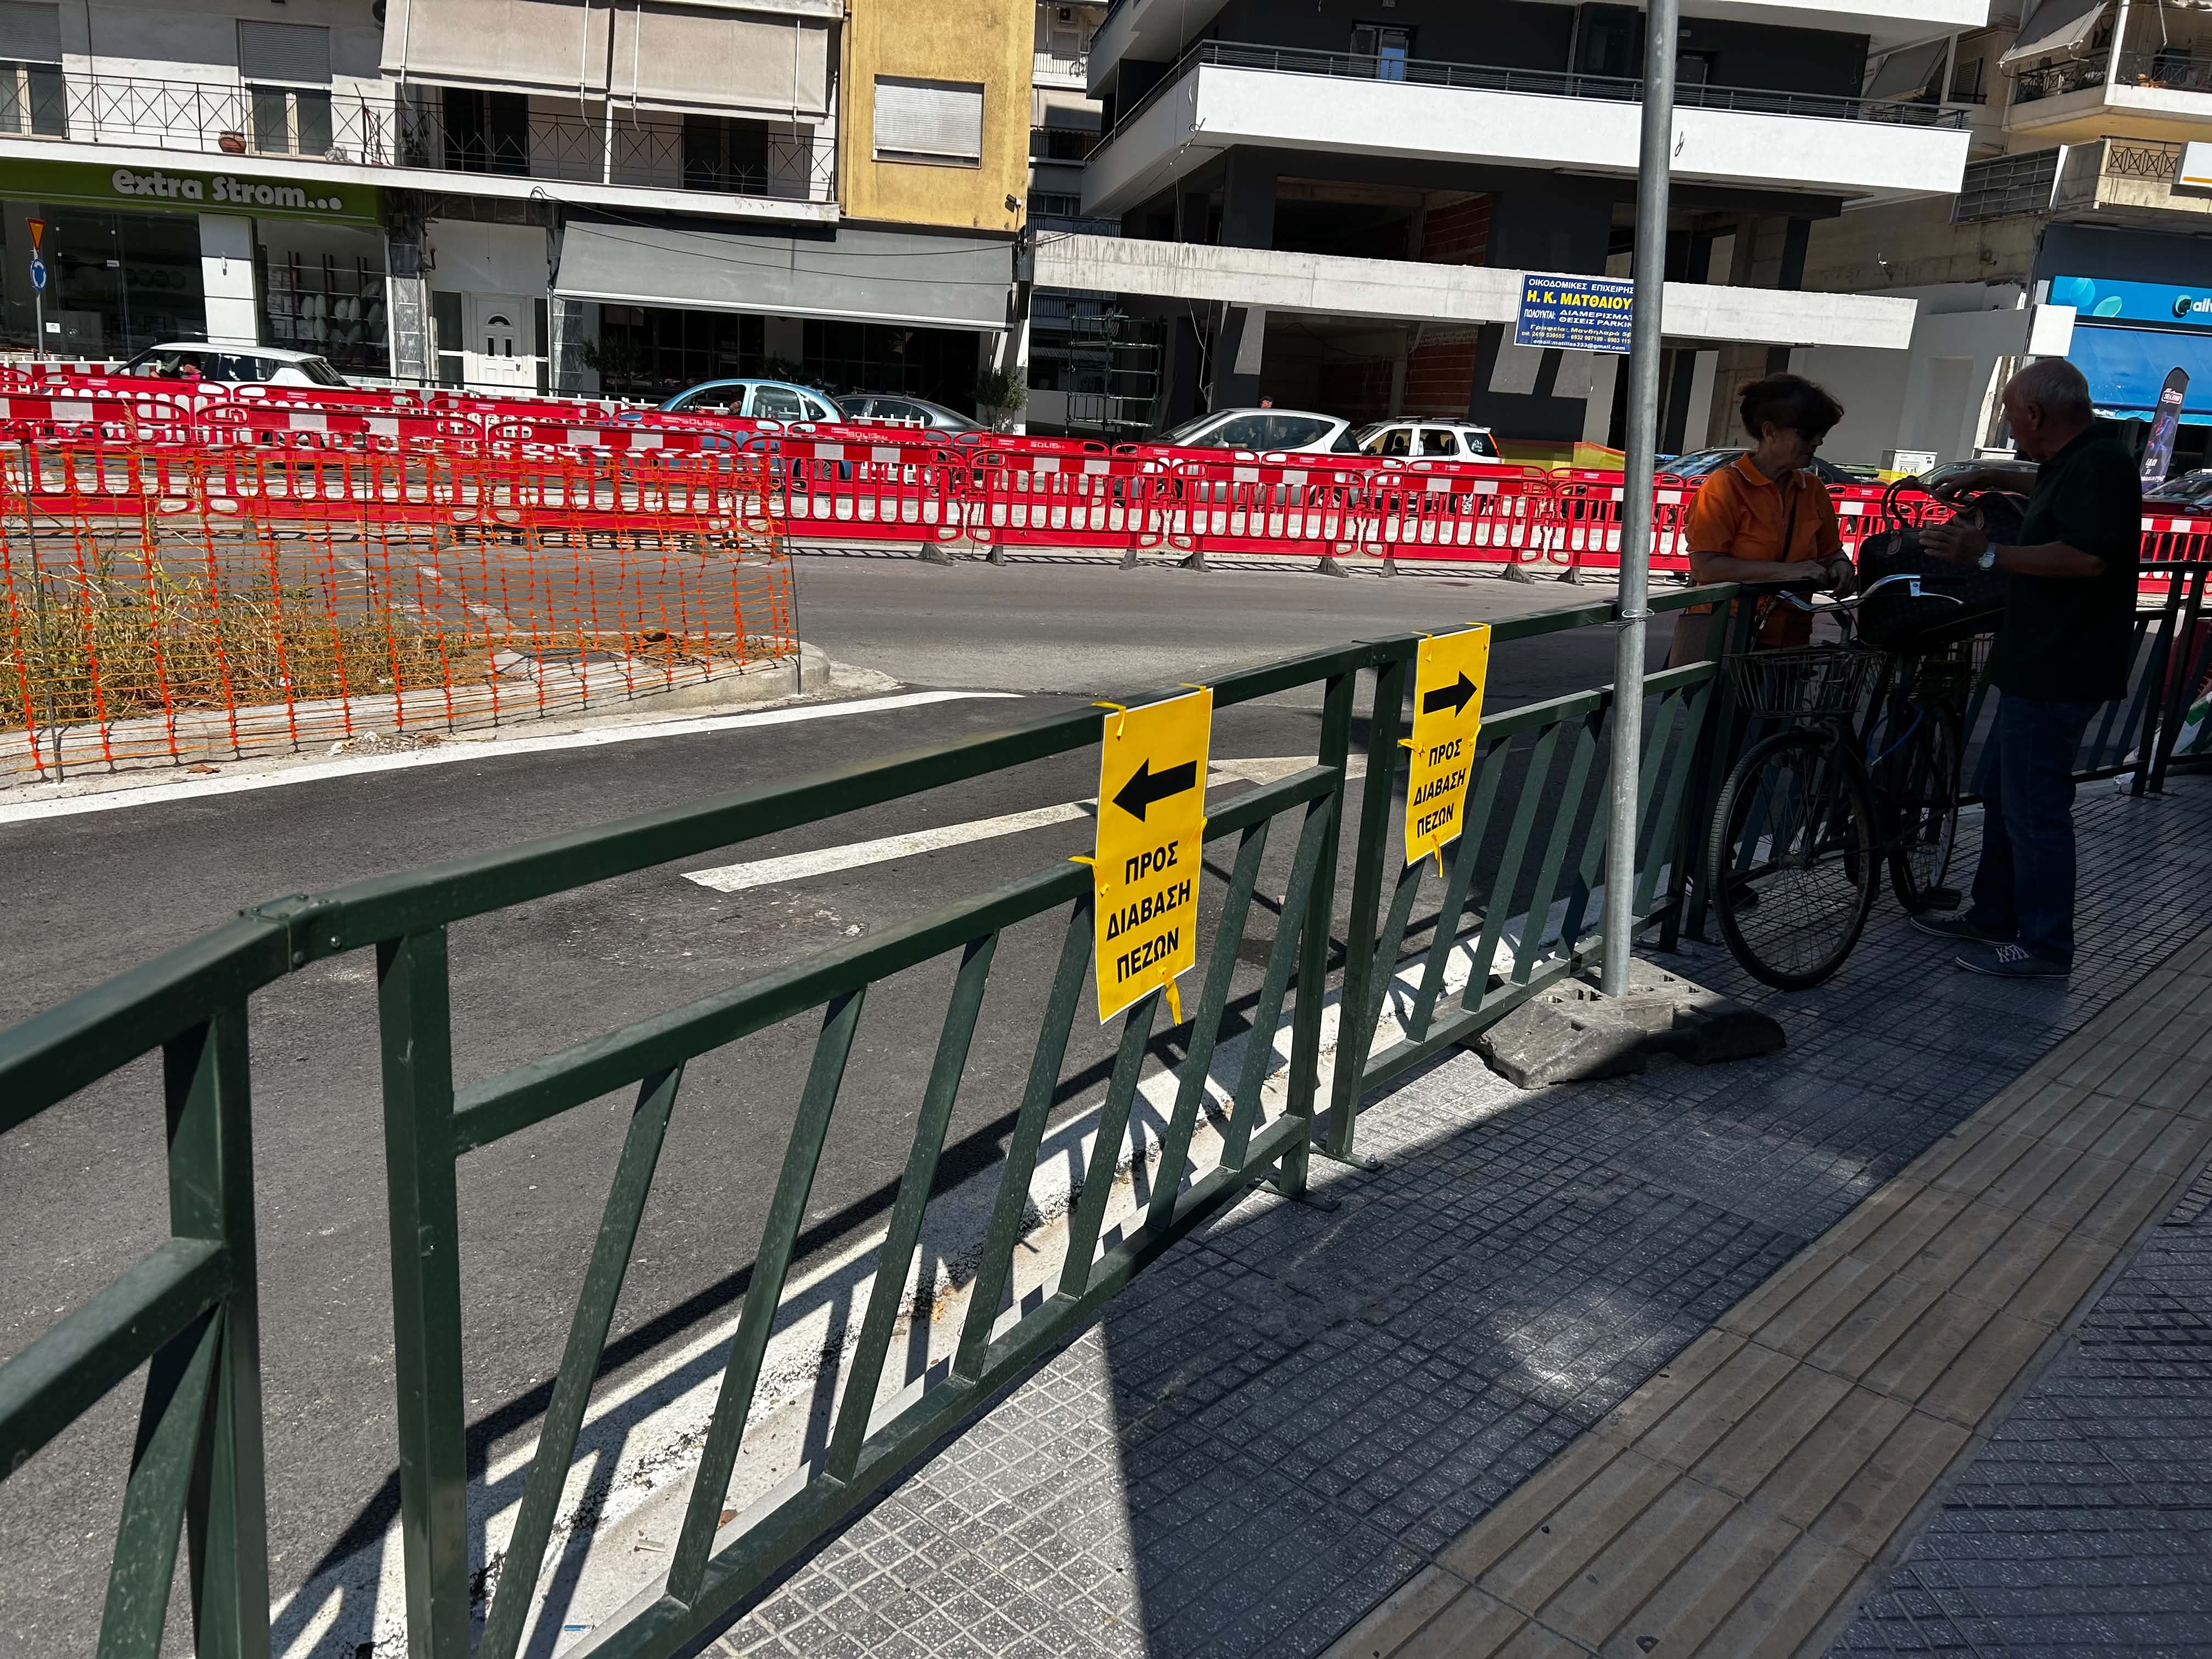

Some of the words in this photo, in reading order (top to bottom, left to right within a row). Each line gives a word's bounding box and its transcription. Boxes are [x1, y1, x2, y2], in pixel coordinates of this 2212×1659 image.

[1528, 279, 1588, 290] ΟΙΚΟΔΟΜΙΚΕΣ
[1527, 290, 1540, 302] Η.
[1543, 291, 1556, 303] Κ.
[1560, 292, 1633, 310] ΜΑΤΘΑΙΟΥ
[2193, 298, 2212, 313] all
[1524, 308, 1556, 319] ΠΩΛΟΥΝΤΑΙ:
[1559, 317, 1595, 325] ΘΕΣΕΙΣ
[1571, 327, 1620, 337] Μανδηλαρά
[1429, 738, 1462, 768] ΠΡΟΣ
[1413, 768, 1466, 806] ΔΙΑΒΑΣΗ
[1417, 803, 1454, 838] ΠΕΖΩΝ
[1125, 840, 1178, 885] ΠΡΟΣ
[1106, 878, 1191, 941] ΔΙΑΒΑΣΗ
[1116, 927, 1179, 983] ΠΕΖΩΝ
